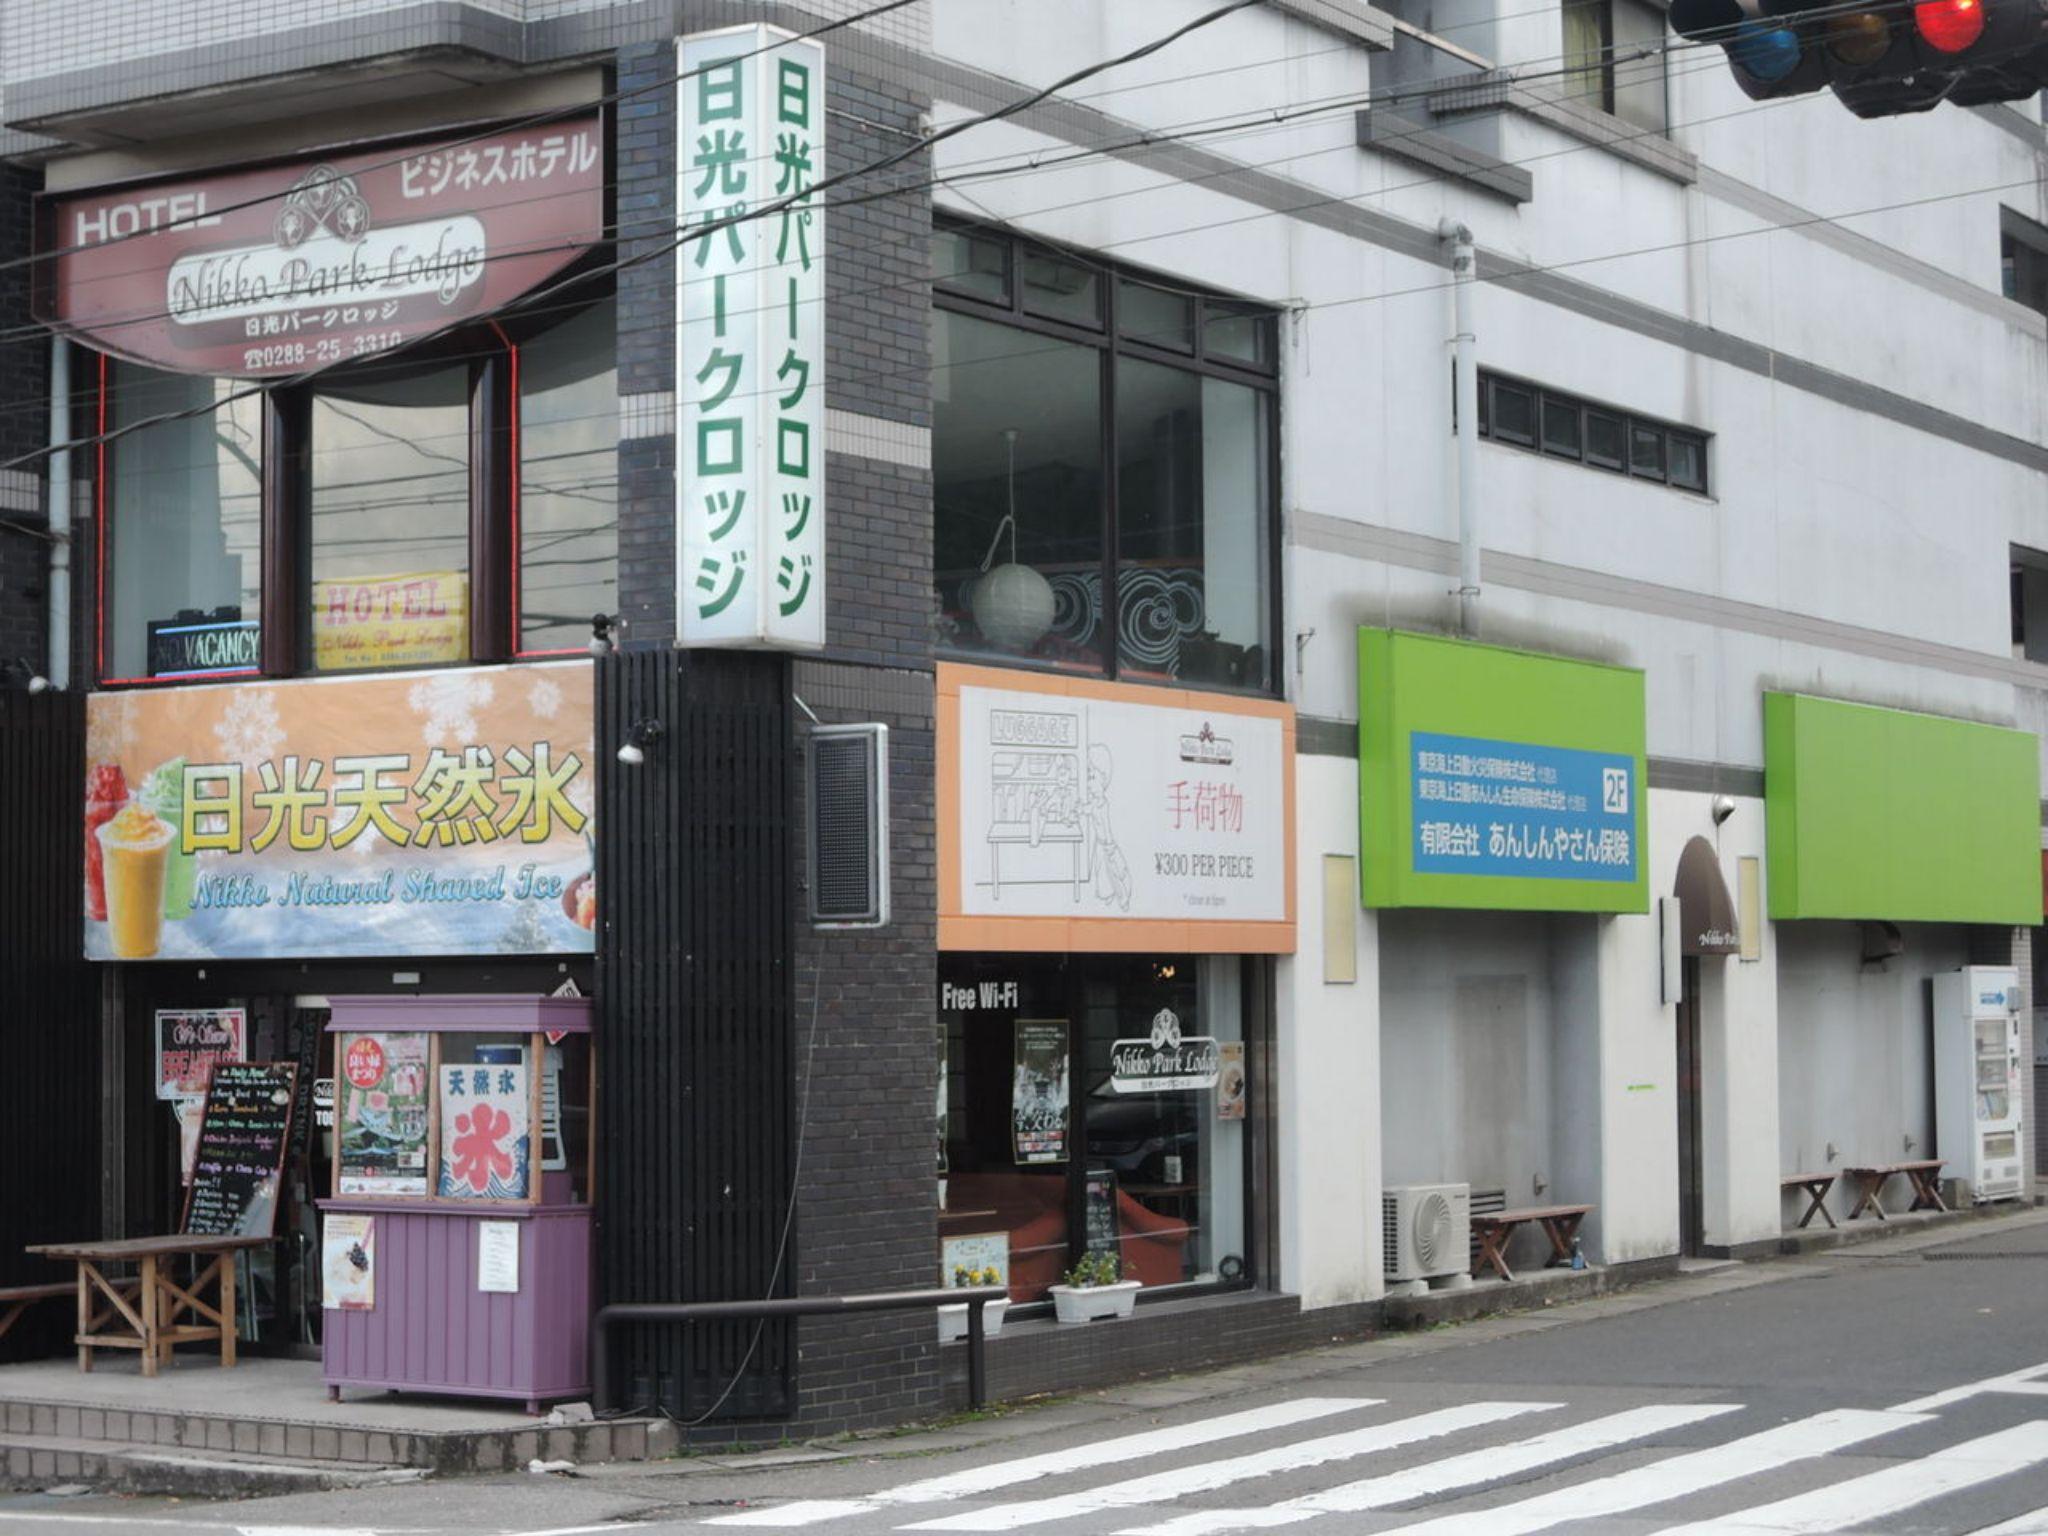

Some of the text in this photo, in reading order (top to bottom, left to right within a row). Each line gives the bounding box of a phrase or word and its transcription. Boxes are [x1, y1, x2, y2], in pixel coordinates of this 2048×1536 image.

[401, 131, 597, 199] ビジネスホテル
[77, 192, 222, 247] HOTEL
[172, 228, 484, 318] Nikko Park Lodge
[245, 299, 399, 337] 日光パークロッジ
[693, 56, 747, 619] 日光パークロッジ
[776, 57, 812, 617] 日光パークロッジ
[324, 580, 446, 626] HOTEL
[184, 629, 260, 667] VACANCY
[180, 740, 588, 856] 日光天然氷
[1167, 781, 1243, 833] 手荷物
[1607, 773, 1625, 807] 2F
[1154, 853, 1254, 879] ¥300 PER PIECE
[1420, 820, 1630, 866] 有限会社 あんしんやさん保険
[189, 863, 562, 910] Nikko Natural Shaved Ice
[942, 981, 1018, 1011] Free Wi-Fi
[448, 1069, 515, 1096] 天然氷
[1113, 1047, 1151, 1076] Nikko
[1152, 1046, 1183, 1074] Park
[452, 1102, 513, 1192] 氷
